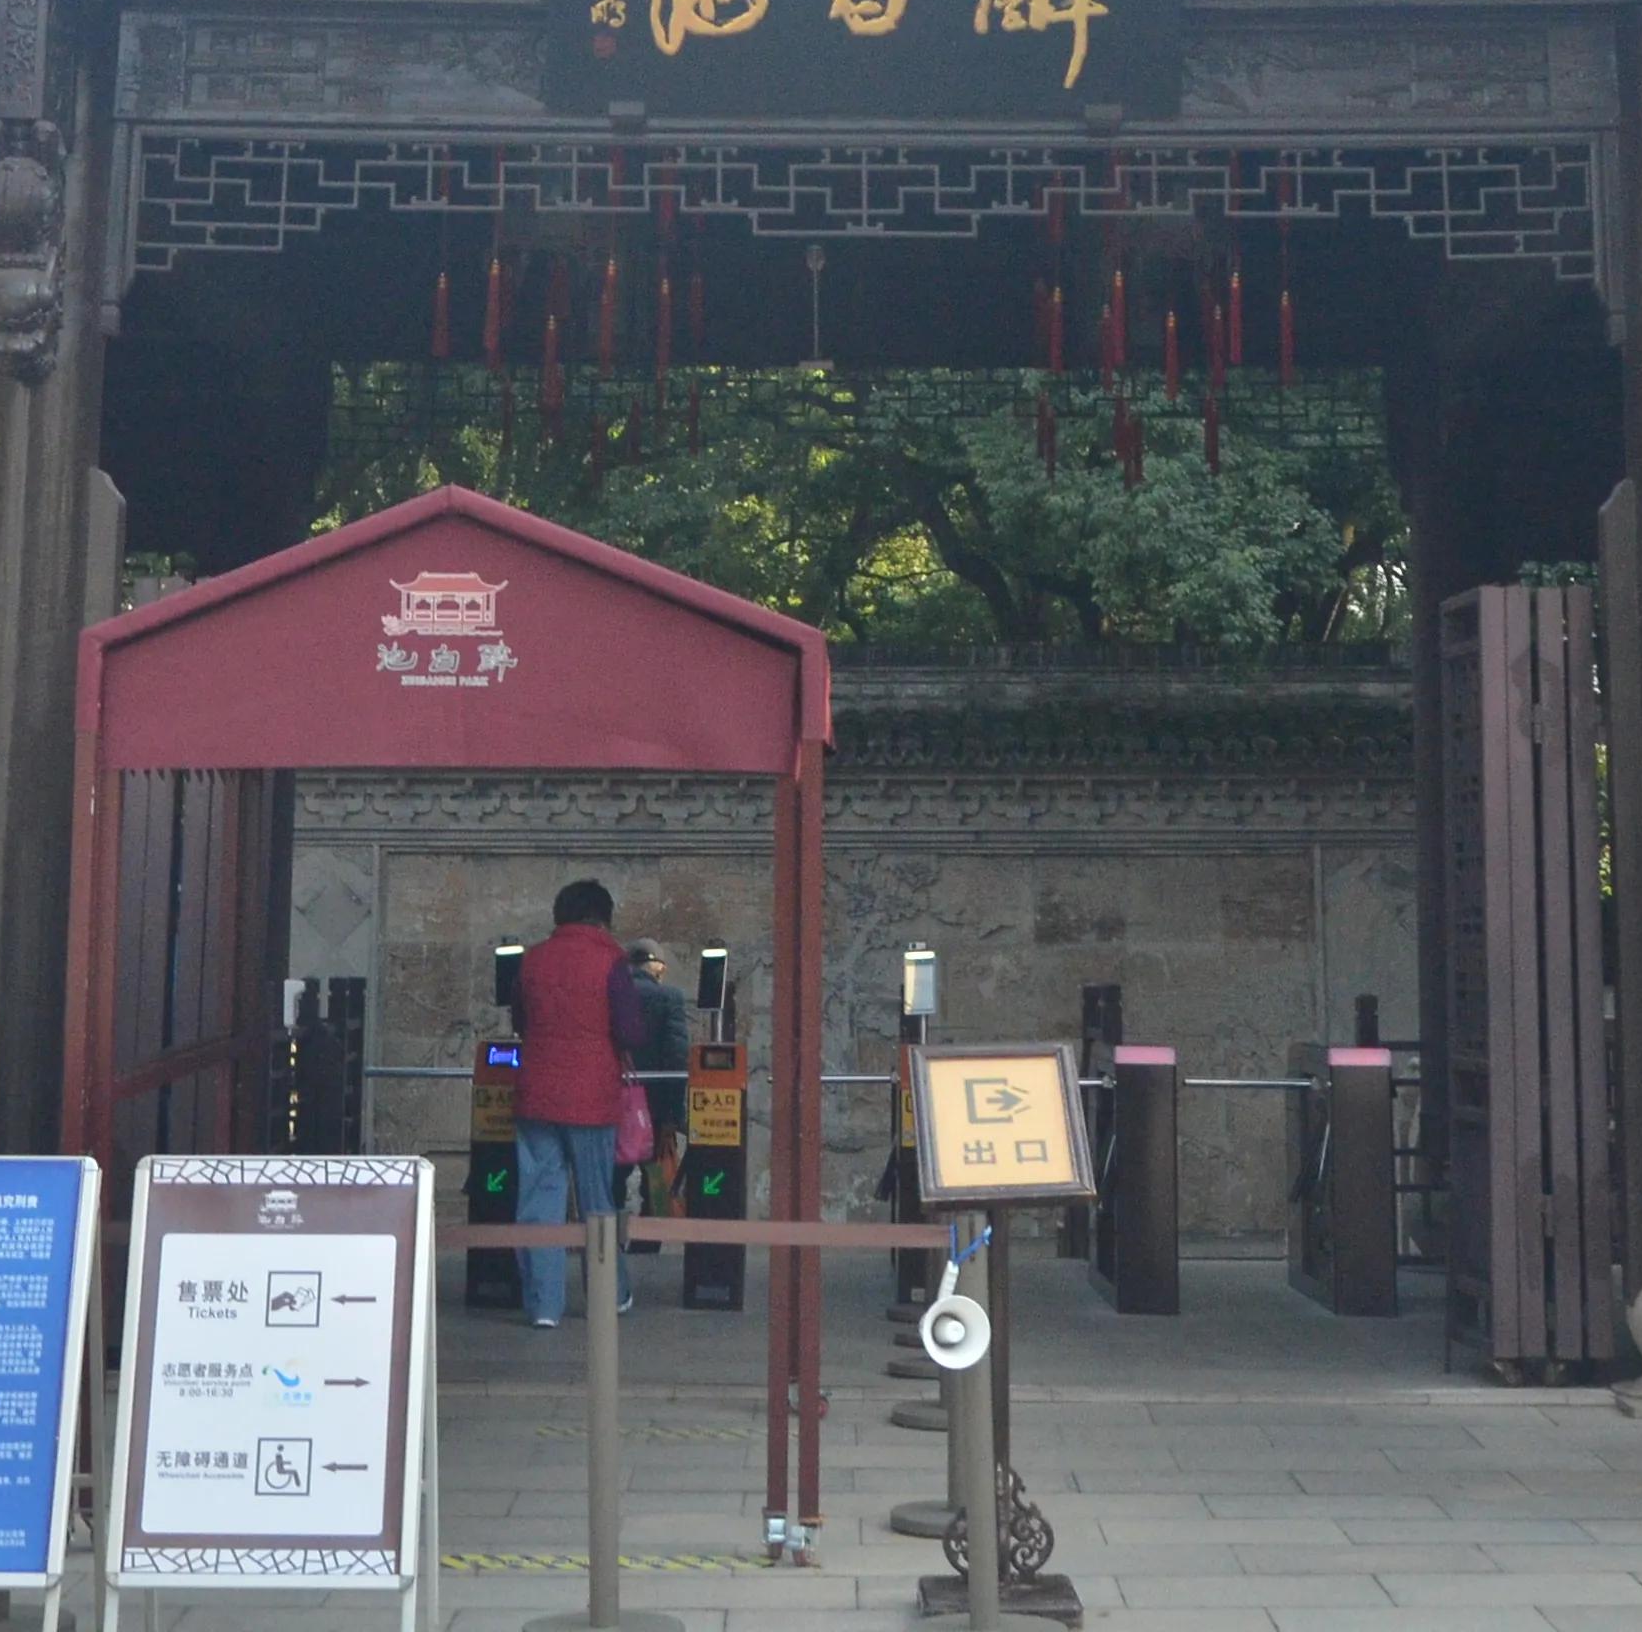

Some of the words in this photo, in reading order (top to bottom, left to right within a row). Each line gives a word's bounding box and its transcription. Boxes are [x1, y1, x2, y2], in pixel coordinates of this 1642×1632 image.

[962, 1138, 1049, 1166] 出口
[176, 1278, 250, 1305] 售票处
[187, 1304, 238, 1320] Tickets
[161, 1361, 254, 1379] 志愿者服务点
[156, 1450, 249, 1470] 无障碍通道
